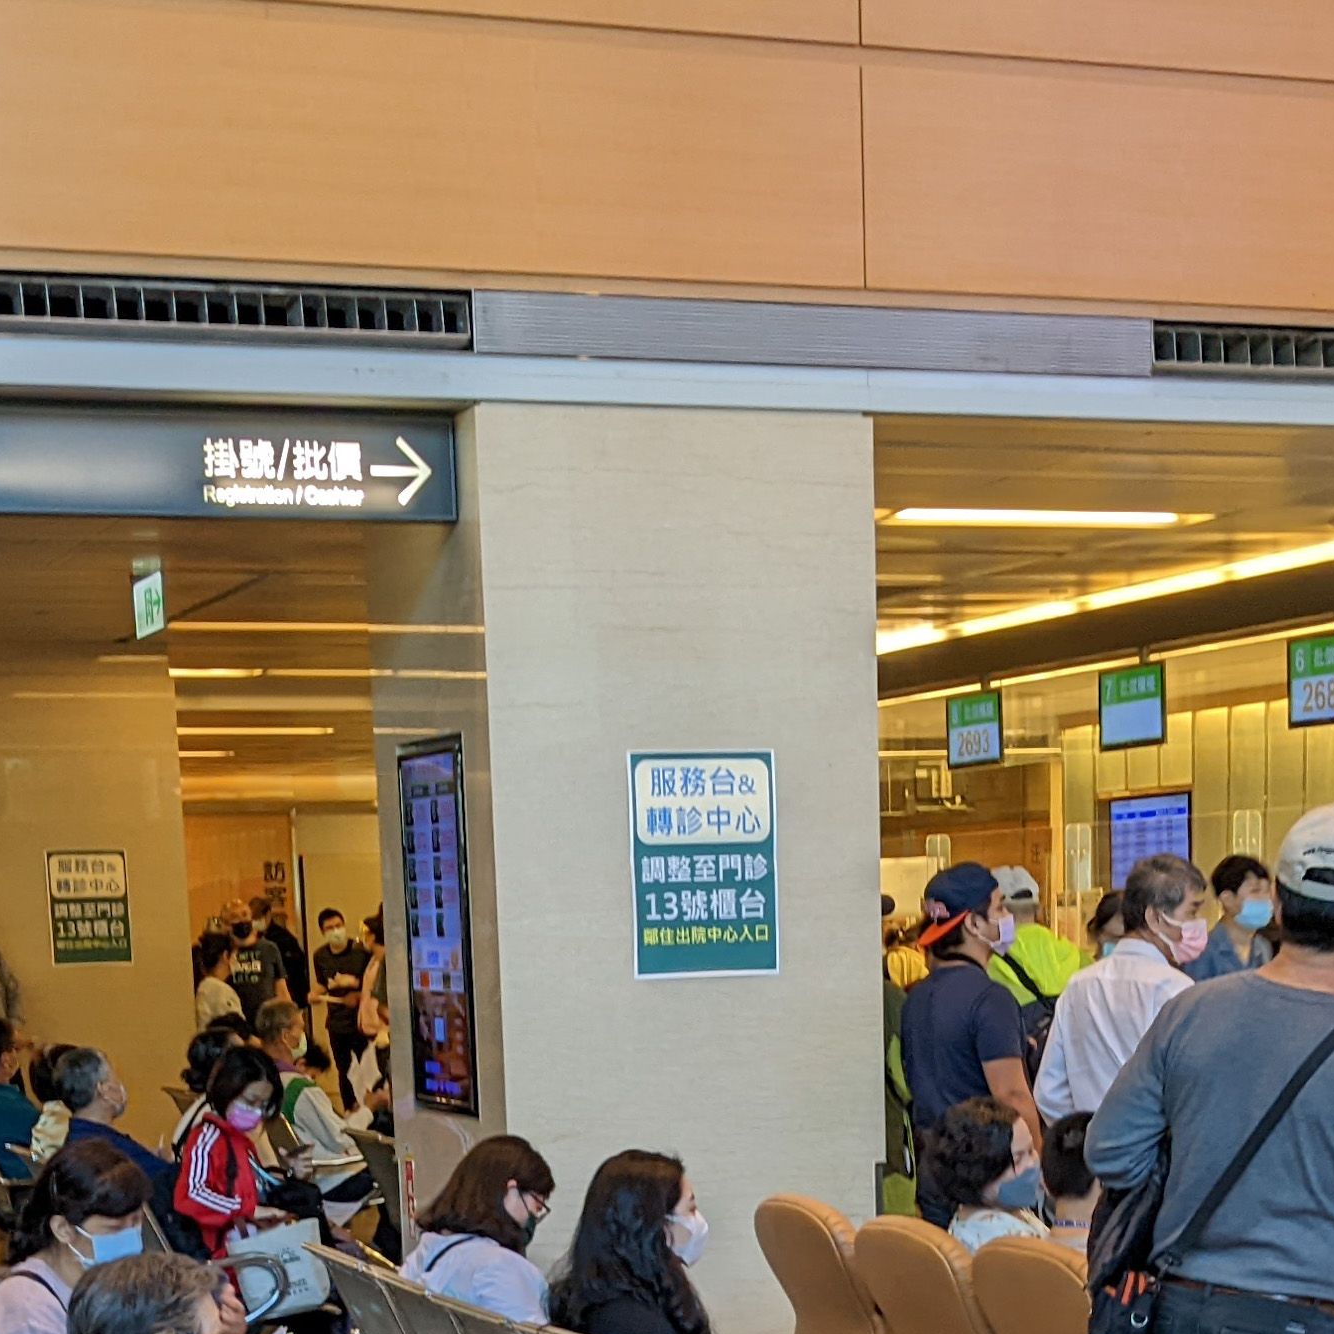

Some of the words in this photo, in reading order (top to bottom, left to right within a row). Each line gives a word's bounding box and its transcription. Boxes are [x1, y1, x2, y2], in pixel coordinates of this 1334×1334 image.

[203, 436, 362, 480] 掛號/批價
[1295, 648, 1306, 673] 6
[956, 730, 990, 758] 2693
[650, 766, 756, 798] 服務台&
[646, 805, 762, 837] 轉診中心
[641, 853, 768, 884] 調整至門診
[645, 888, 766, 921] 13號櫃台
